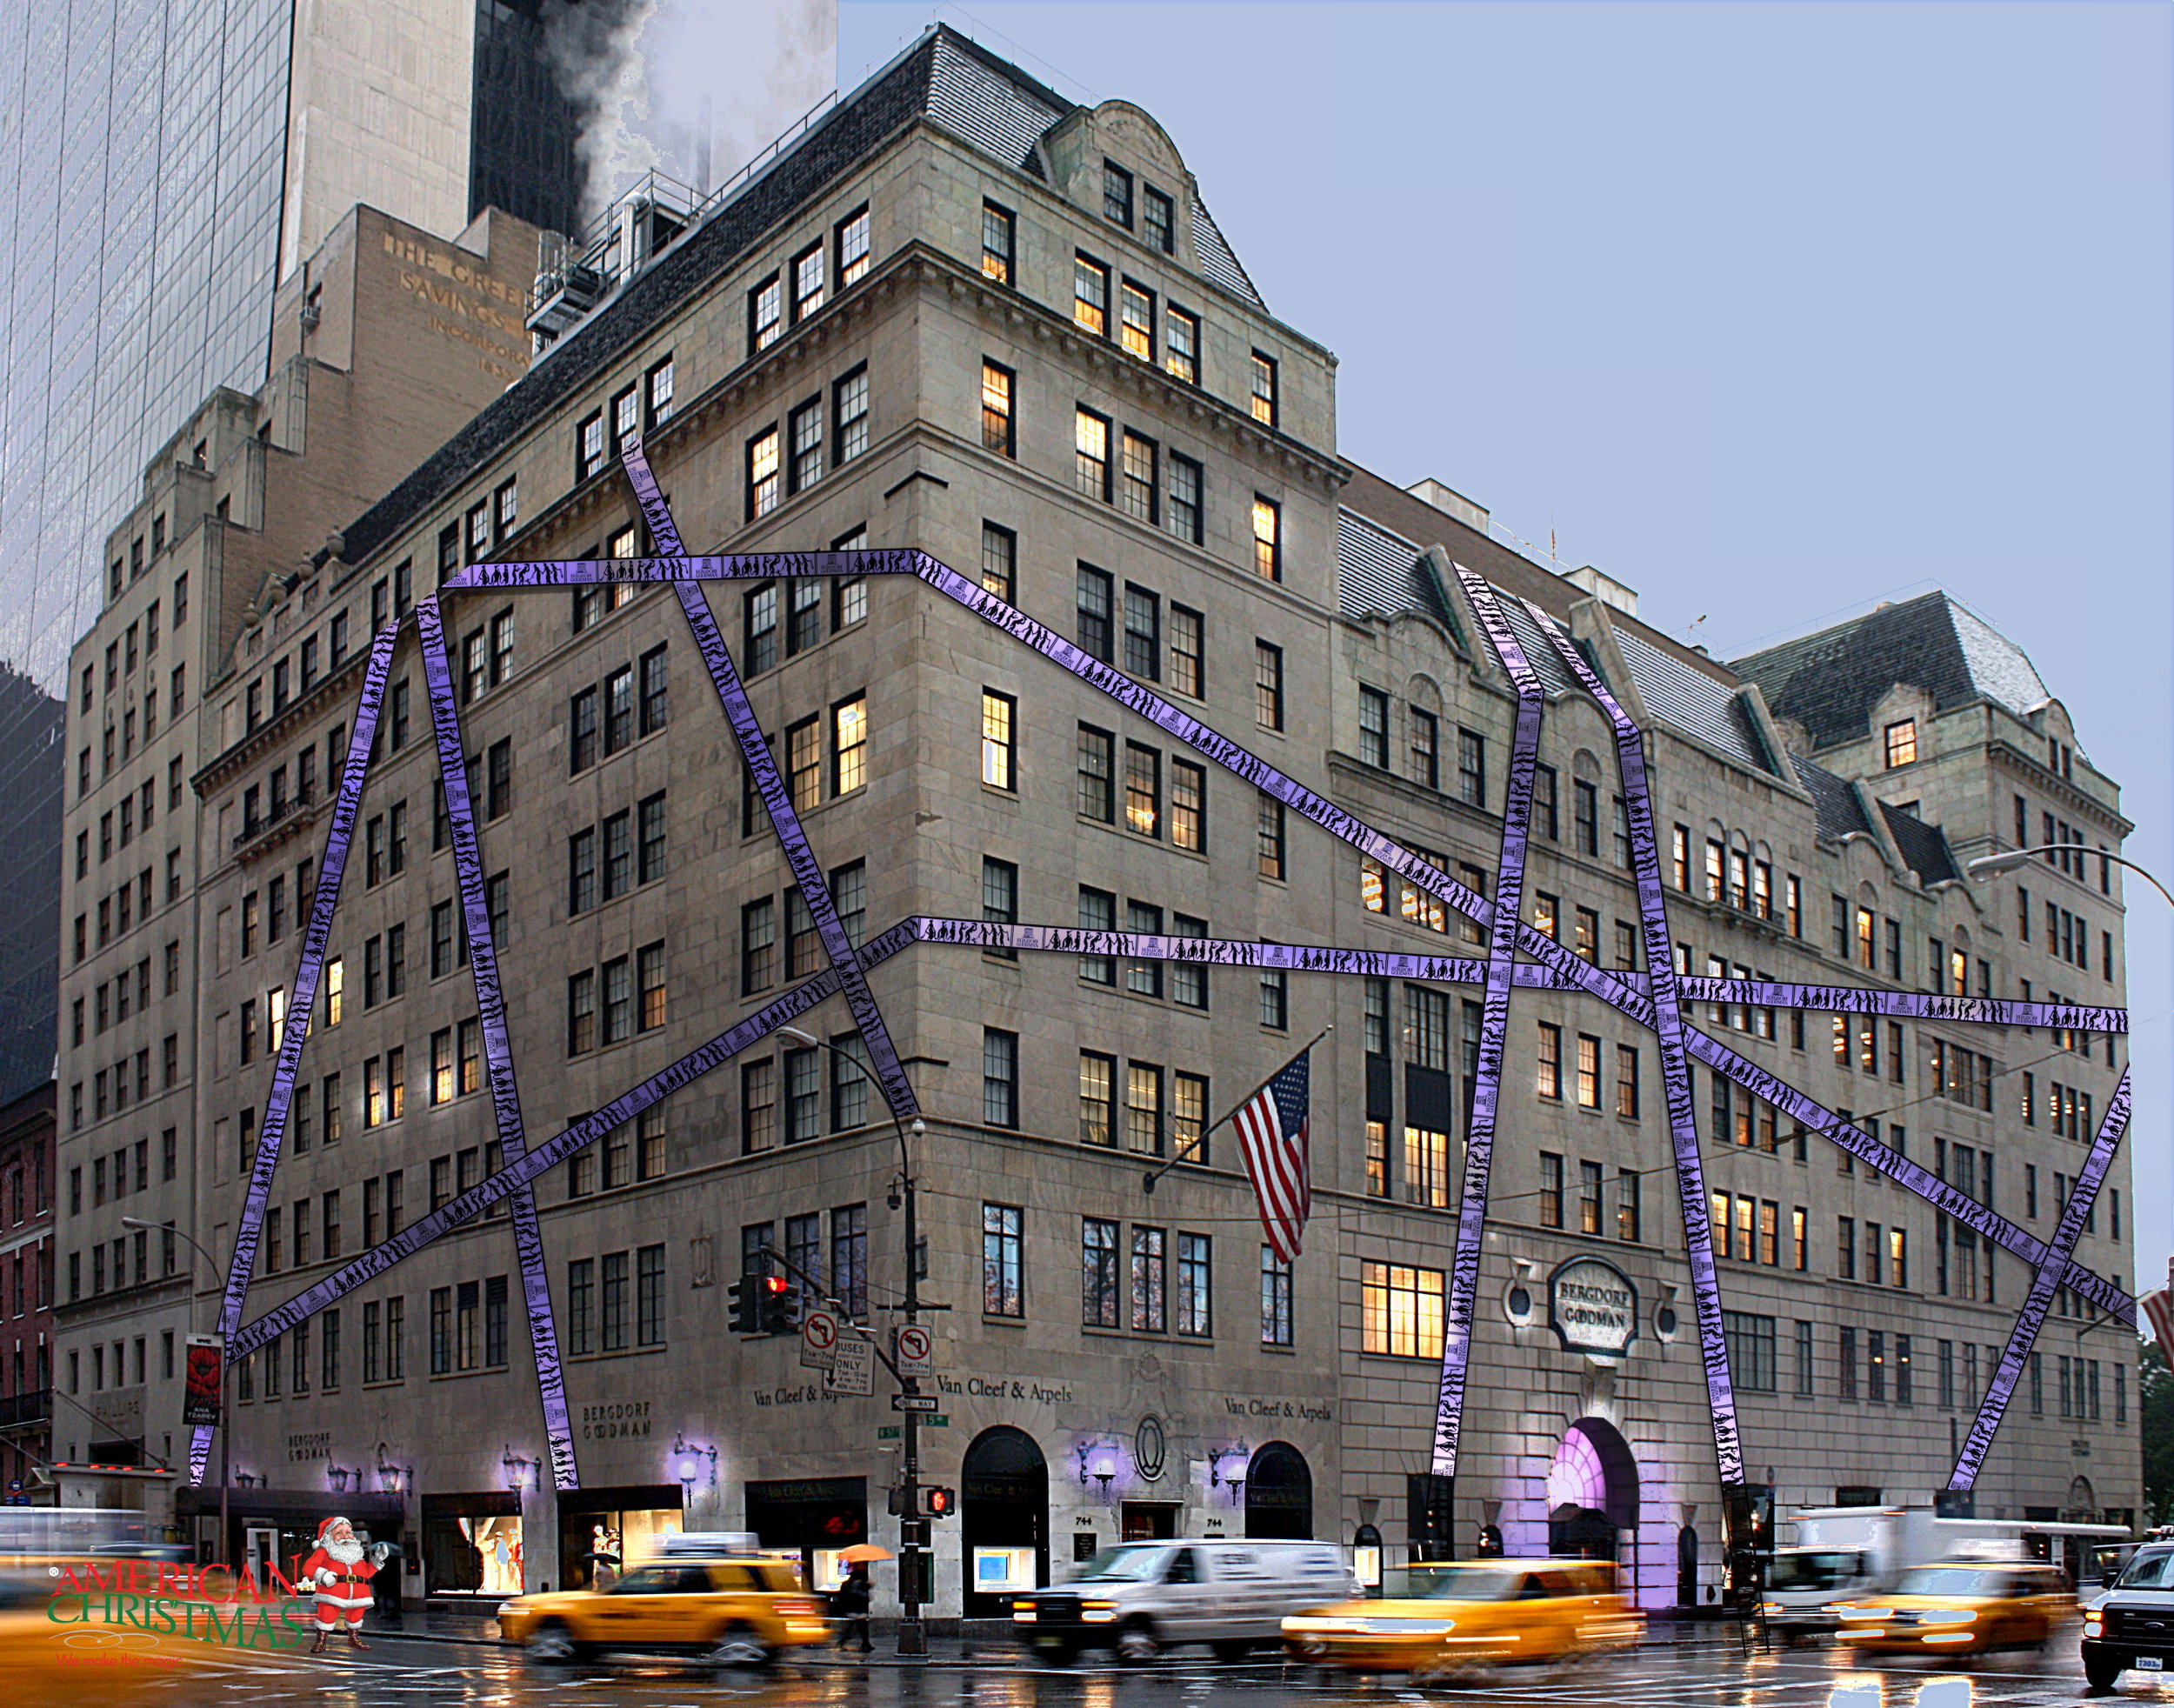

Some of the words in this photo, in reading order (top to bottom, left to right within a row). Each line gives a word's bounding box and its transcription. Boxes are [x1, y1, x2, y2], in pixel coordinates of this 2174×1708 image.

[383, 232, 437, 270] THE
[451, 264, 534, 306] GREE
[400, 270, 505, 329] SAVINGS
[430, 314, 532, 368] INCORPORA
[1560, 1283, 1629, 1304] BERGDORF
[1565, 1307, 1624, 1327] GOODMAN
[836, 1359, 861, 1370] ONLY
[754, 1390, 771, 1405] Van
[775, 1385, 804, 1404] Cleef
[807, 1384, 817, 1401] &
[937, 1375, 962, 1394] Van
[968, 1378, 1007, 1398] Cleef
[1011, 1381, 1025, 1398] &
[1030, 1383, 1071, 1404] Arpels
[584, 1402, 650, 1421] BERGDORF
[899, 1398, 911, 1407] ONE
[1225, 1398, 1244, 1414] Van
[1250, 1399, 1280, 1416] Cleef
[1284, 1402, 1294, 1418] &
[1298, 1404, 1330, 1422] Arpels
[584, 1420, 650, 1438] GOODMAN
[289, 1432, 330, 1447] BERGDORF
[1076, 1517, 1092, 1525] 744
